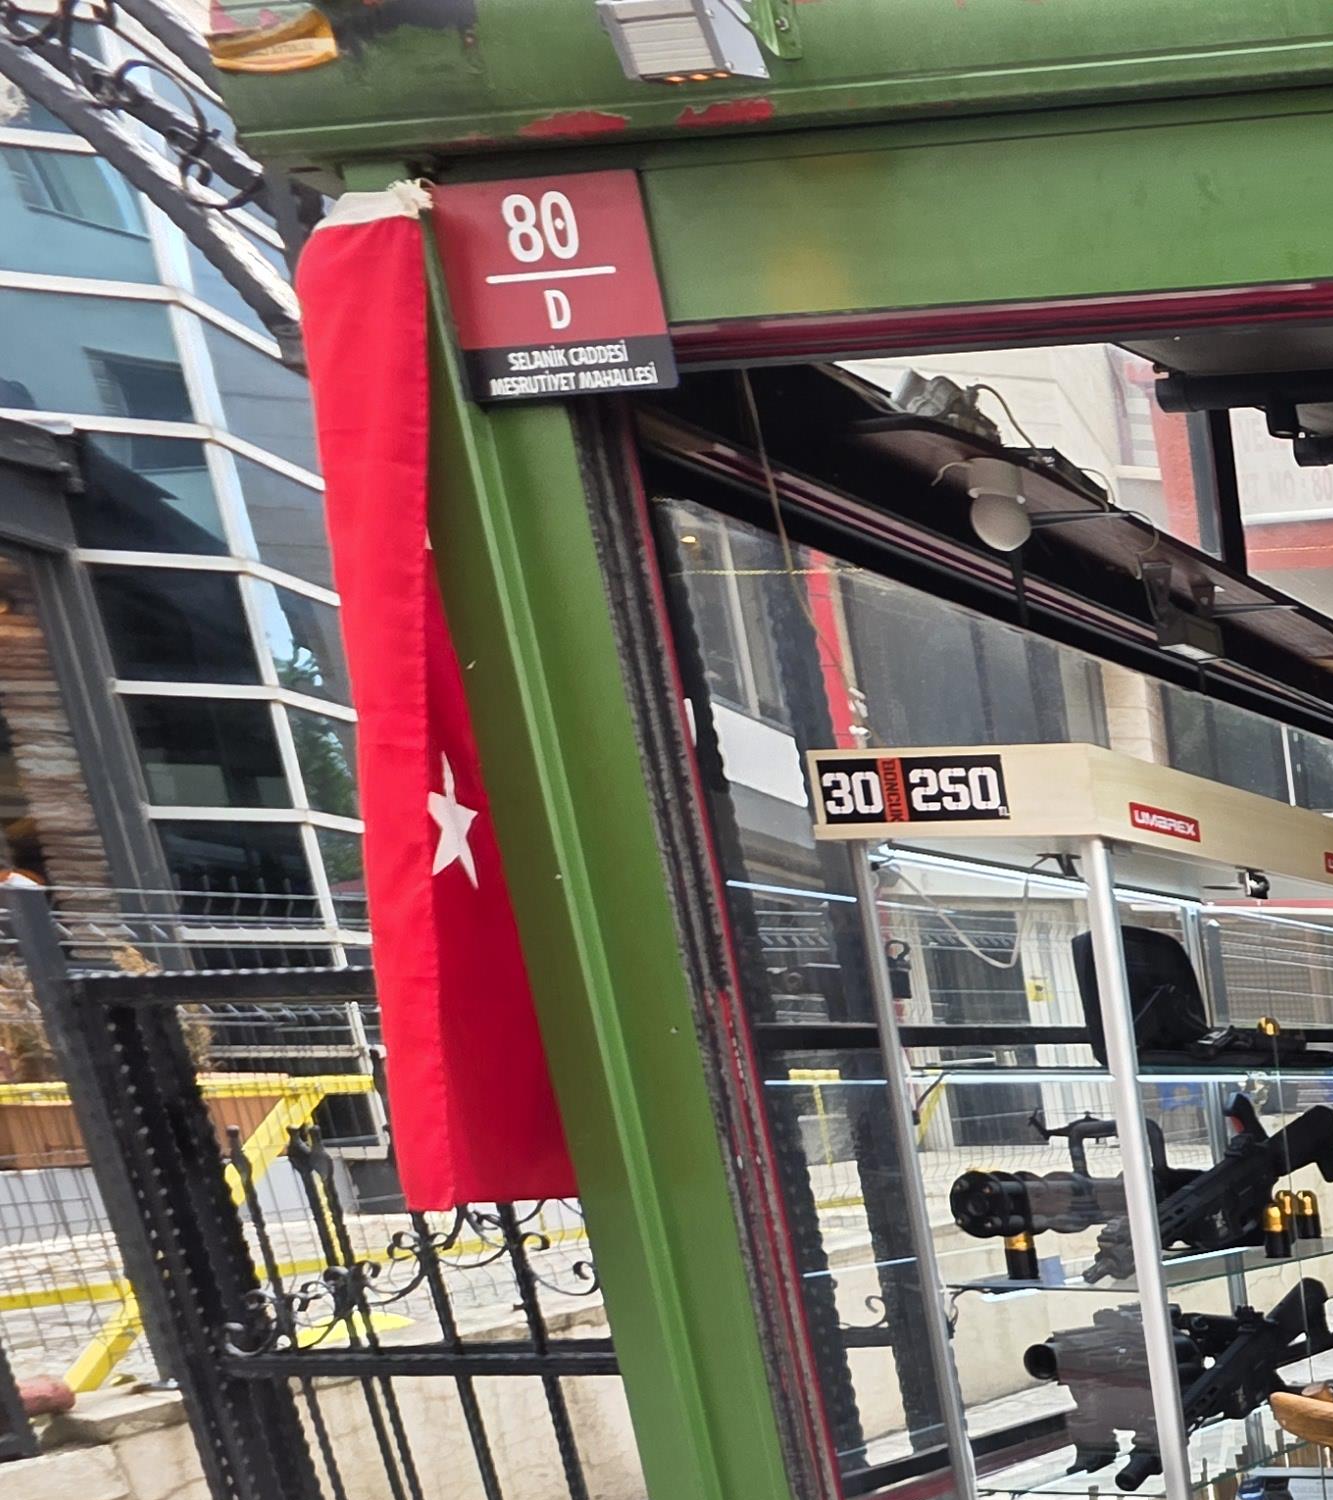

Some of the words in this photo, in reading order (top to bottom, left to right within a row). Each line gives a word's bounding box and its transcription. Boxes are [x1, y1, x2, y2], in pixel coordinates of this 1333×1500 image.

[501, 190, 580, 263] 80
[543, 289, 572, 330] D
[507, 344, 569, 371] SELANİK
[569, 339, 629, 366] CADDESİ
[578, 361, 659, 389] MAHALLESİ
[822, 771, 884, 815] 30
[908, 766, 1001, 811] 250
